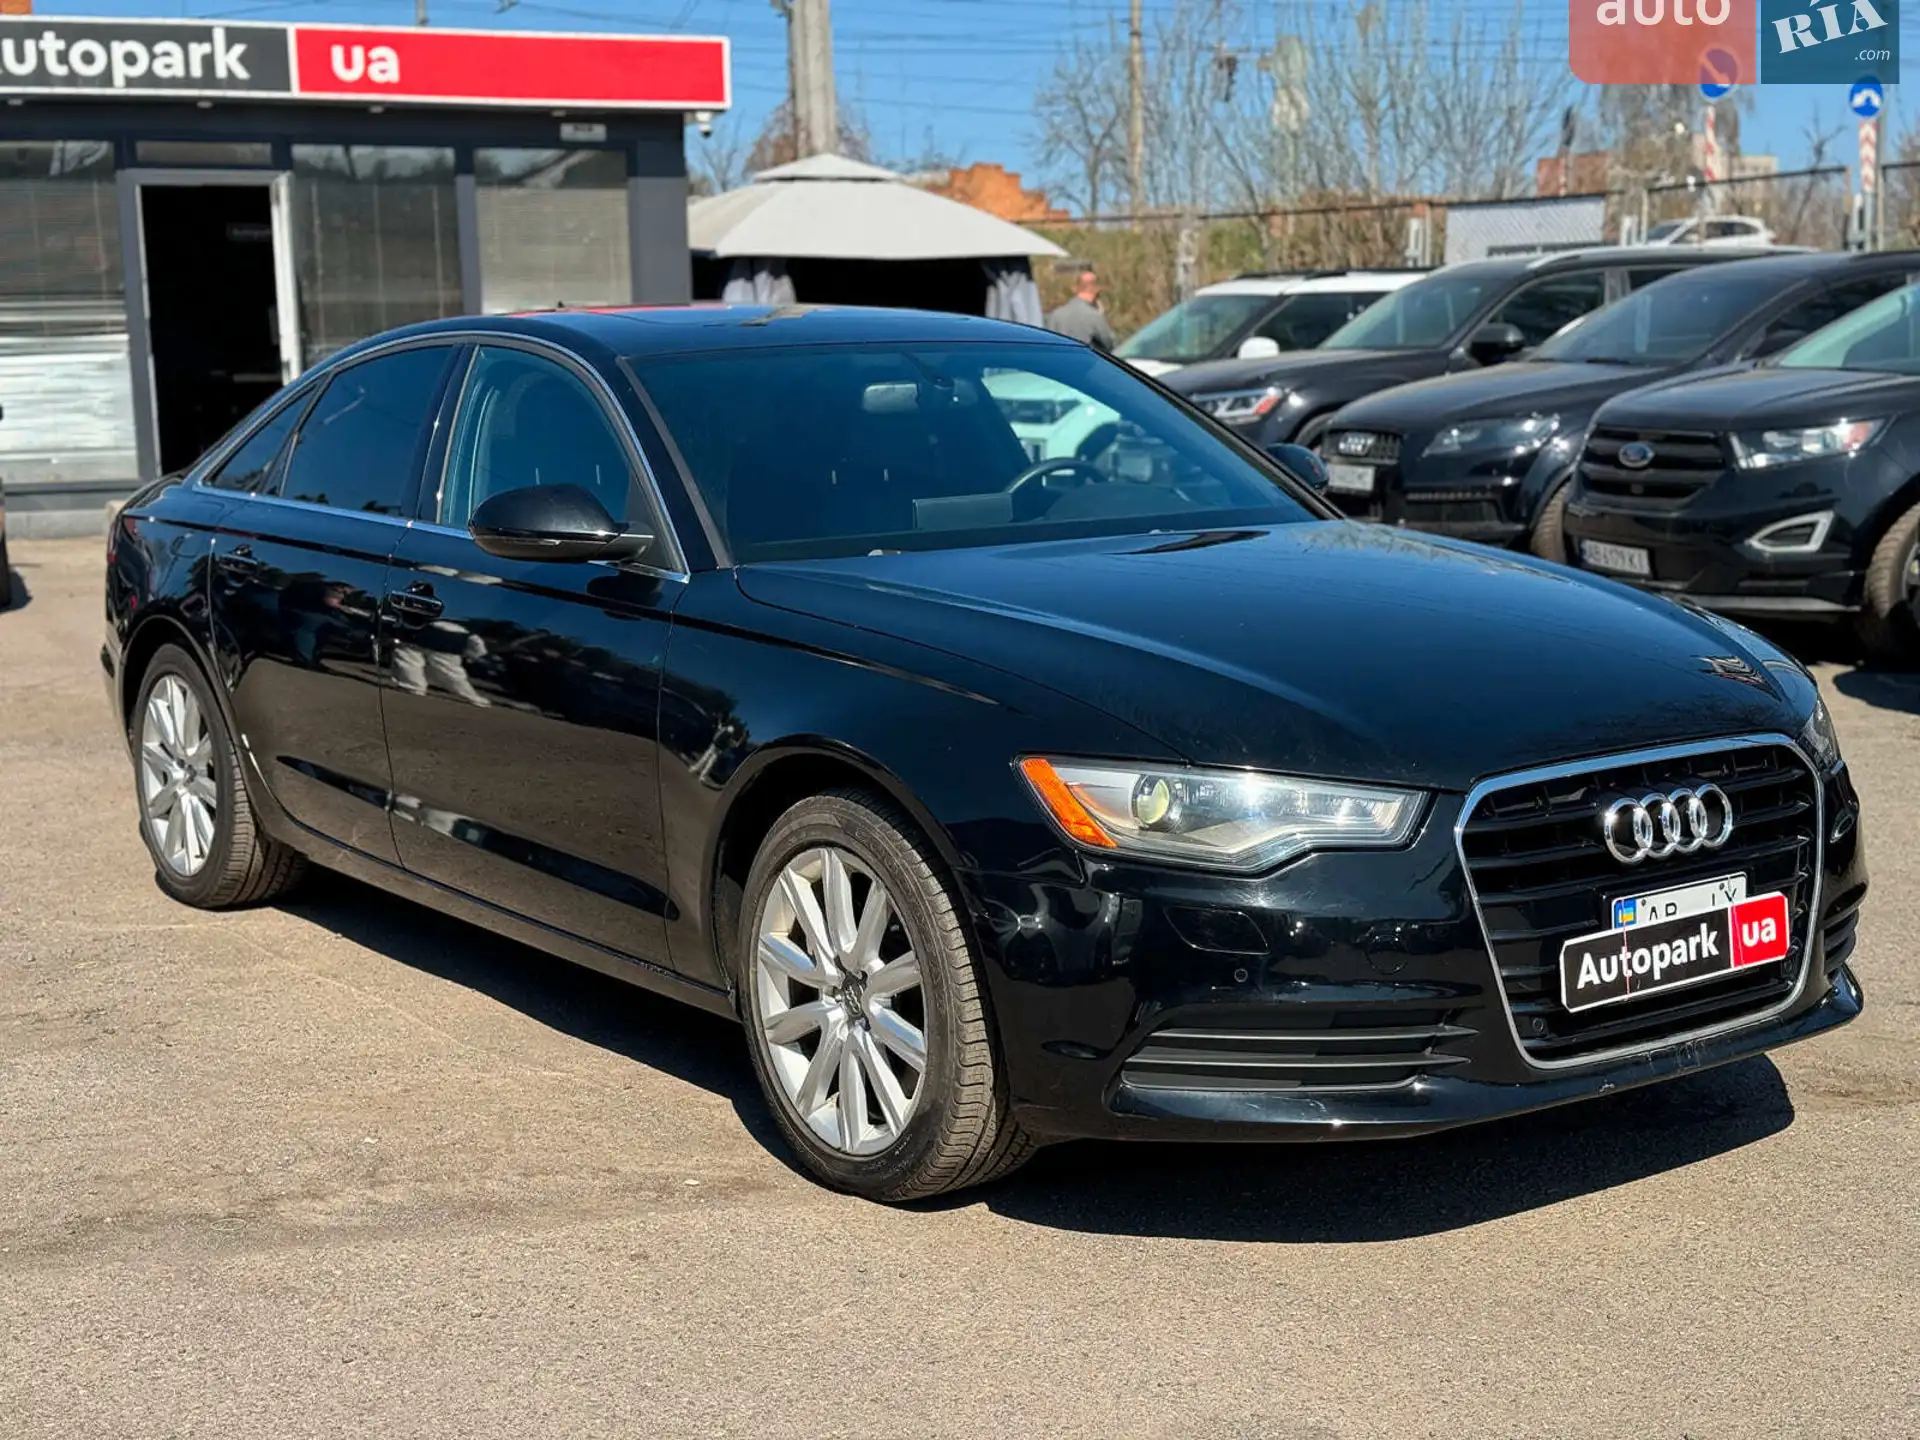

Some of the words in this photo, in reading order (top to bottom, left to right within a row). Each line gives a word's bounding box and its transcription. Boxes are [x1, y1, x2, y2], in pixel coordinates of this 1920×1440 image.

[0, 26, 251, 88] utopark
[331, 44, 400, 83] ua
[1576, 922, 1720, 989] Autopark
[1741, 916, 1777, 947] ua
